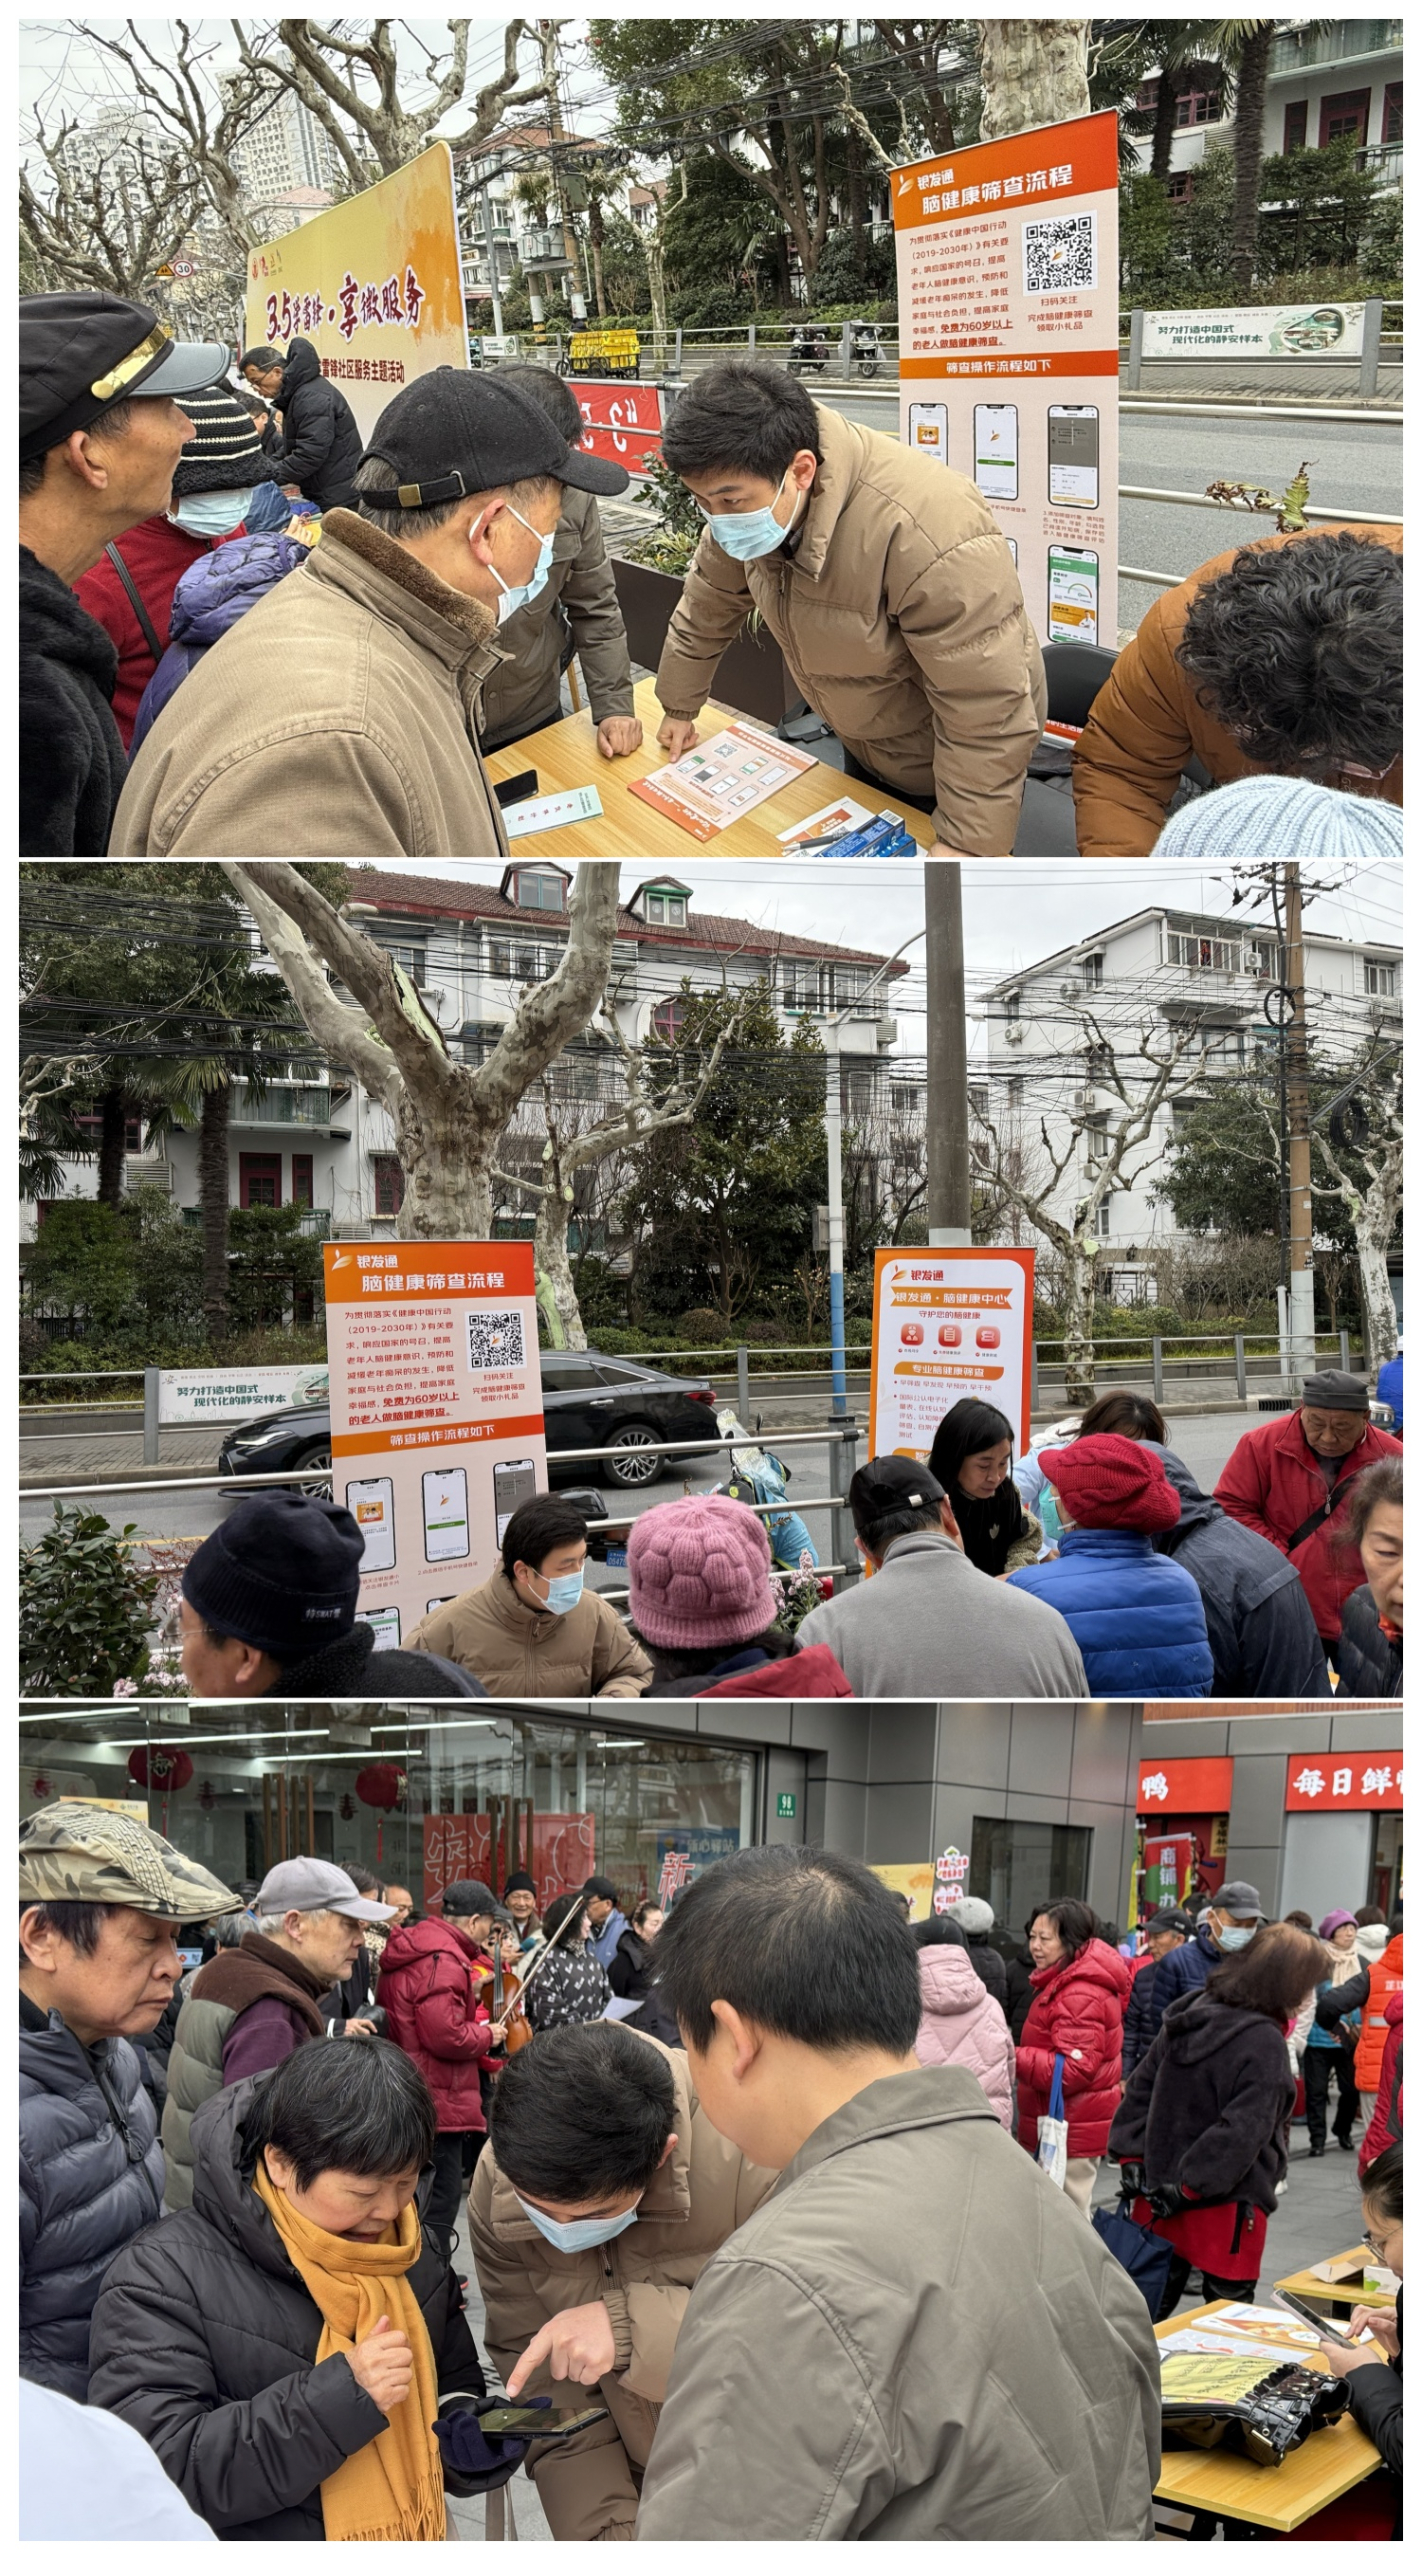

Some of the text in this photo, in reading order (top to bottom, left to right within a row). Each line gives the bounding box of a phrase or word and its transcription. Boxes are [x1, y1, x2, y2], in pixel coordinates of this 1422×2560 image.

[917, 168, 955, 190] 银发通
[922, 164, 1073, 215] 脑健康筛查流程
[178, 265, 190, 273] 30
[1041, 295, 1078, 307] 扫码关注
[1028, 309, 1093, 323] 完成脑健康筛查
[1158, 324, 1234, 335] 努力打造中国式
[1172, 334, 1263, 345] 现代化的静安样本
[318, 356, 405, 384] 雷锋社区服务主题活动
[946, 358, 1052, 375] 筛查操作流程如下
[357, 1254, 398, 1269] 银发通
[362, 1272, 505, 1293] 脑健康筛查流程
[910, 1270, 945, 1282] 银发通
[345, 1307, 452, 1320] 为贯彻落实《健康中国行动
[918, 1310, 981, 1320] 守护您的脑健康
[483, 1372, 514, 1382] 扫码关注
[912, 1364, 985, 1377] 专业脑健康筛查
[177, 1384, 259, 1397] 努力打造中国式
[472, 1383, 526, 1395] 完成脑健康筛查
[194, 1394, 287, 1407] 现代化的静安样本
[390, 1424, 495, 1446] 筛查操作流程如下
[1142, 1772, 1169, 1800] 鸭
